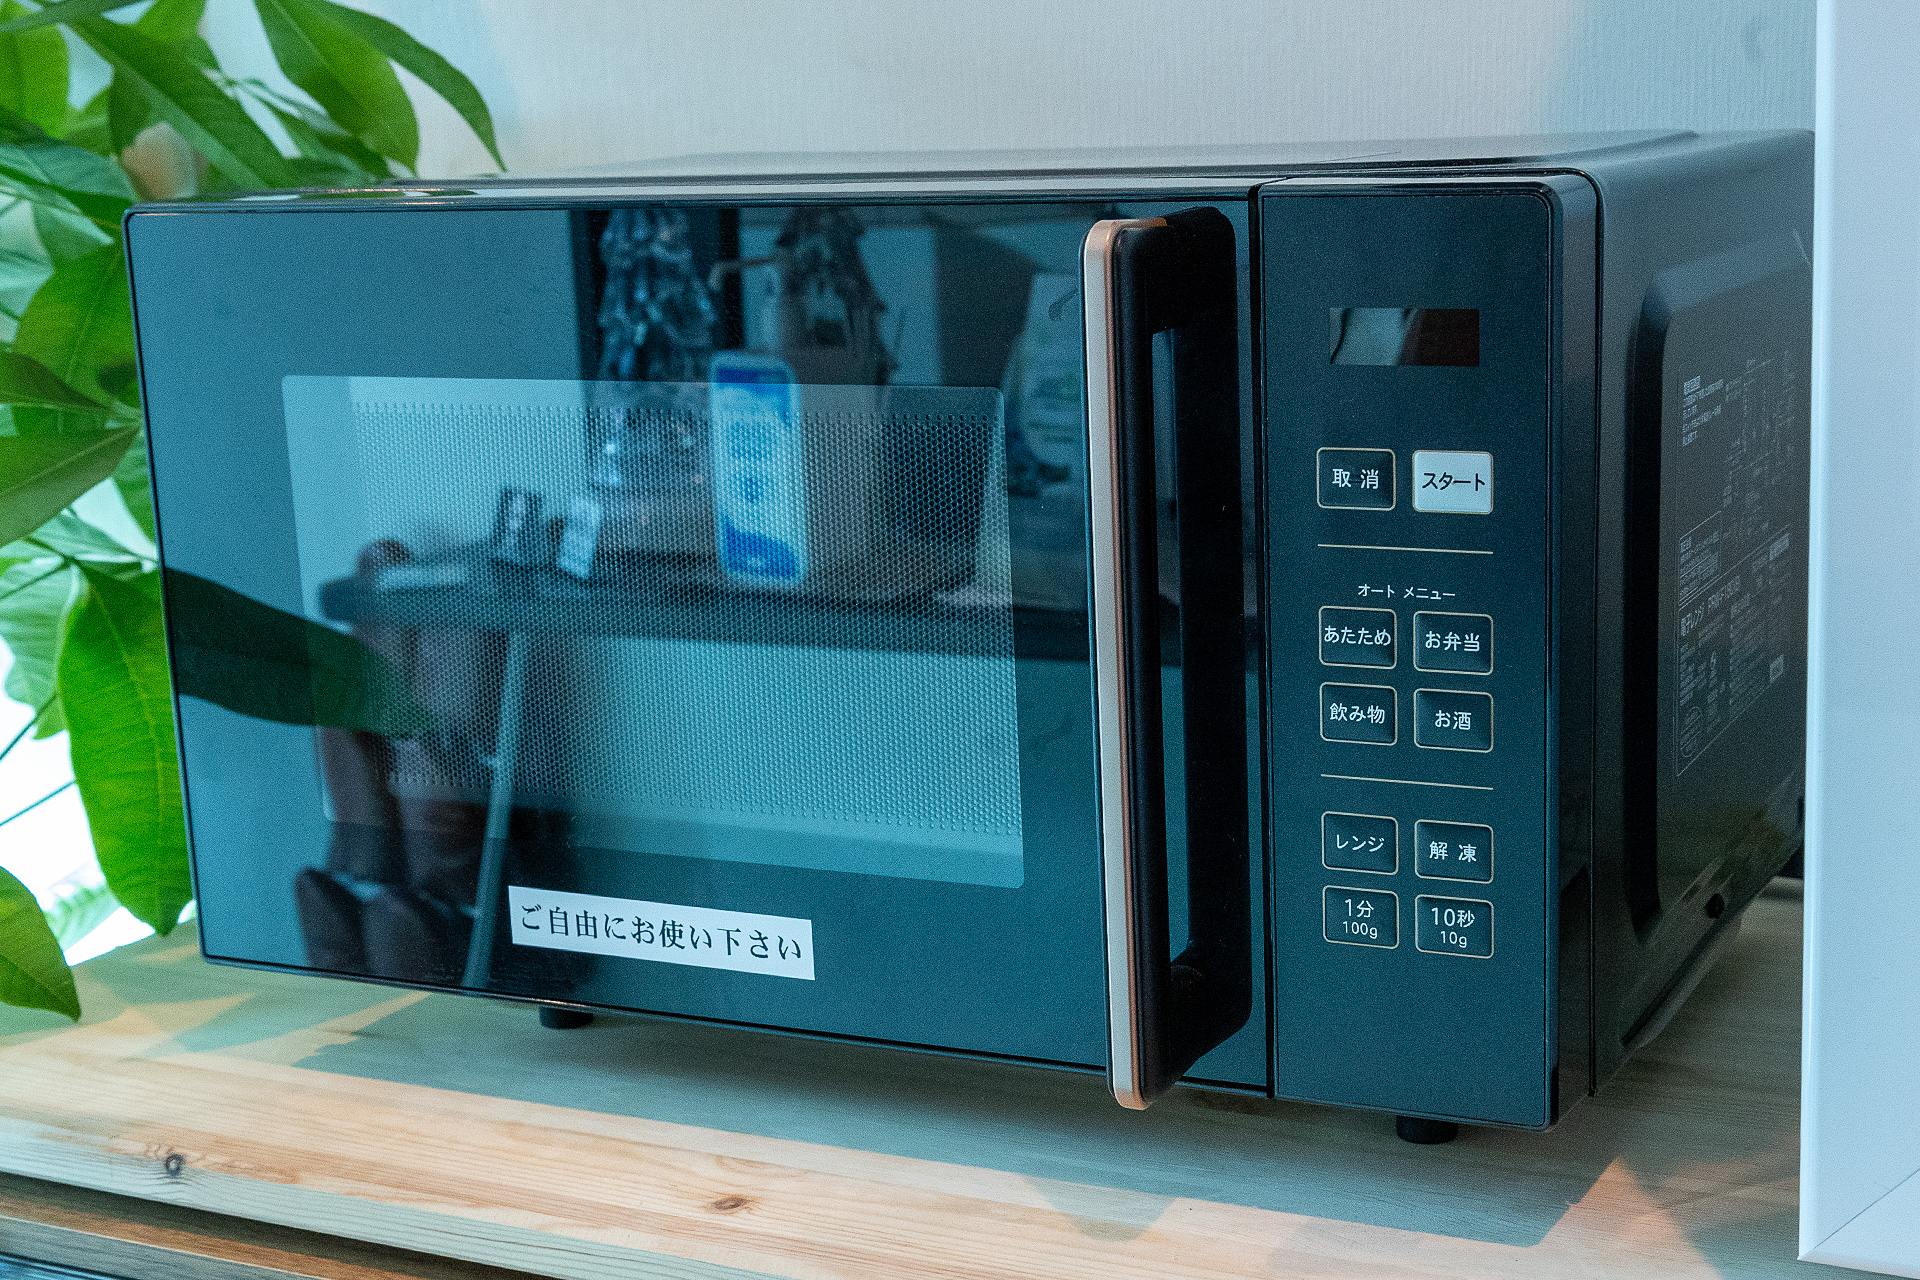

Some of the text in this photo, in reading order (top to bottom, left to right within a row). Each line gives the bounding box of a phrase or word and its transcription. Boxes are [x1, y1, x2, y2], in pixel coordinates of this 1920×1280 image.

[1421, 471, 1486, 492] スタート
[1357, 583, 1456, 600] オート メニュー
[1323, 624, 1392, 646] あたため
[1424, 630, 1480, 652] お弁当
[1329, 702, 1386, 725] 飲み物
[1434, 709, 1472, 731] お酒
[1336, 834, 1385, 853] レンジ
[1344, 898, 1375, 919] 1分
[1431, 907, 1476, 928] 10秒
[521, 903, 802, 960] ご自由にお使い下さい
[1342, 920, 1378, 940] 100g
[1440, 930, 1468, 949] 10g
